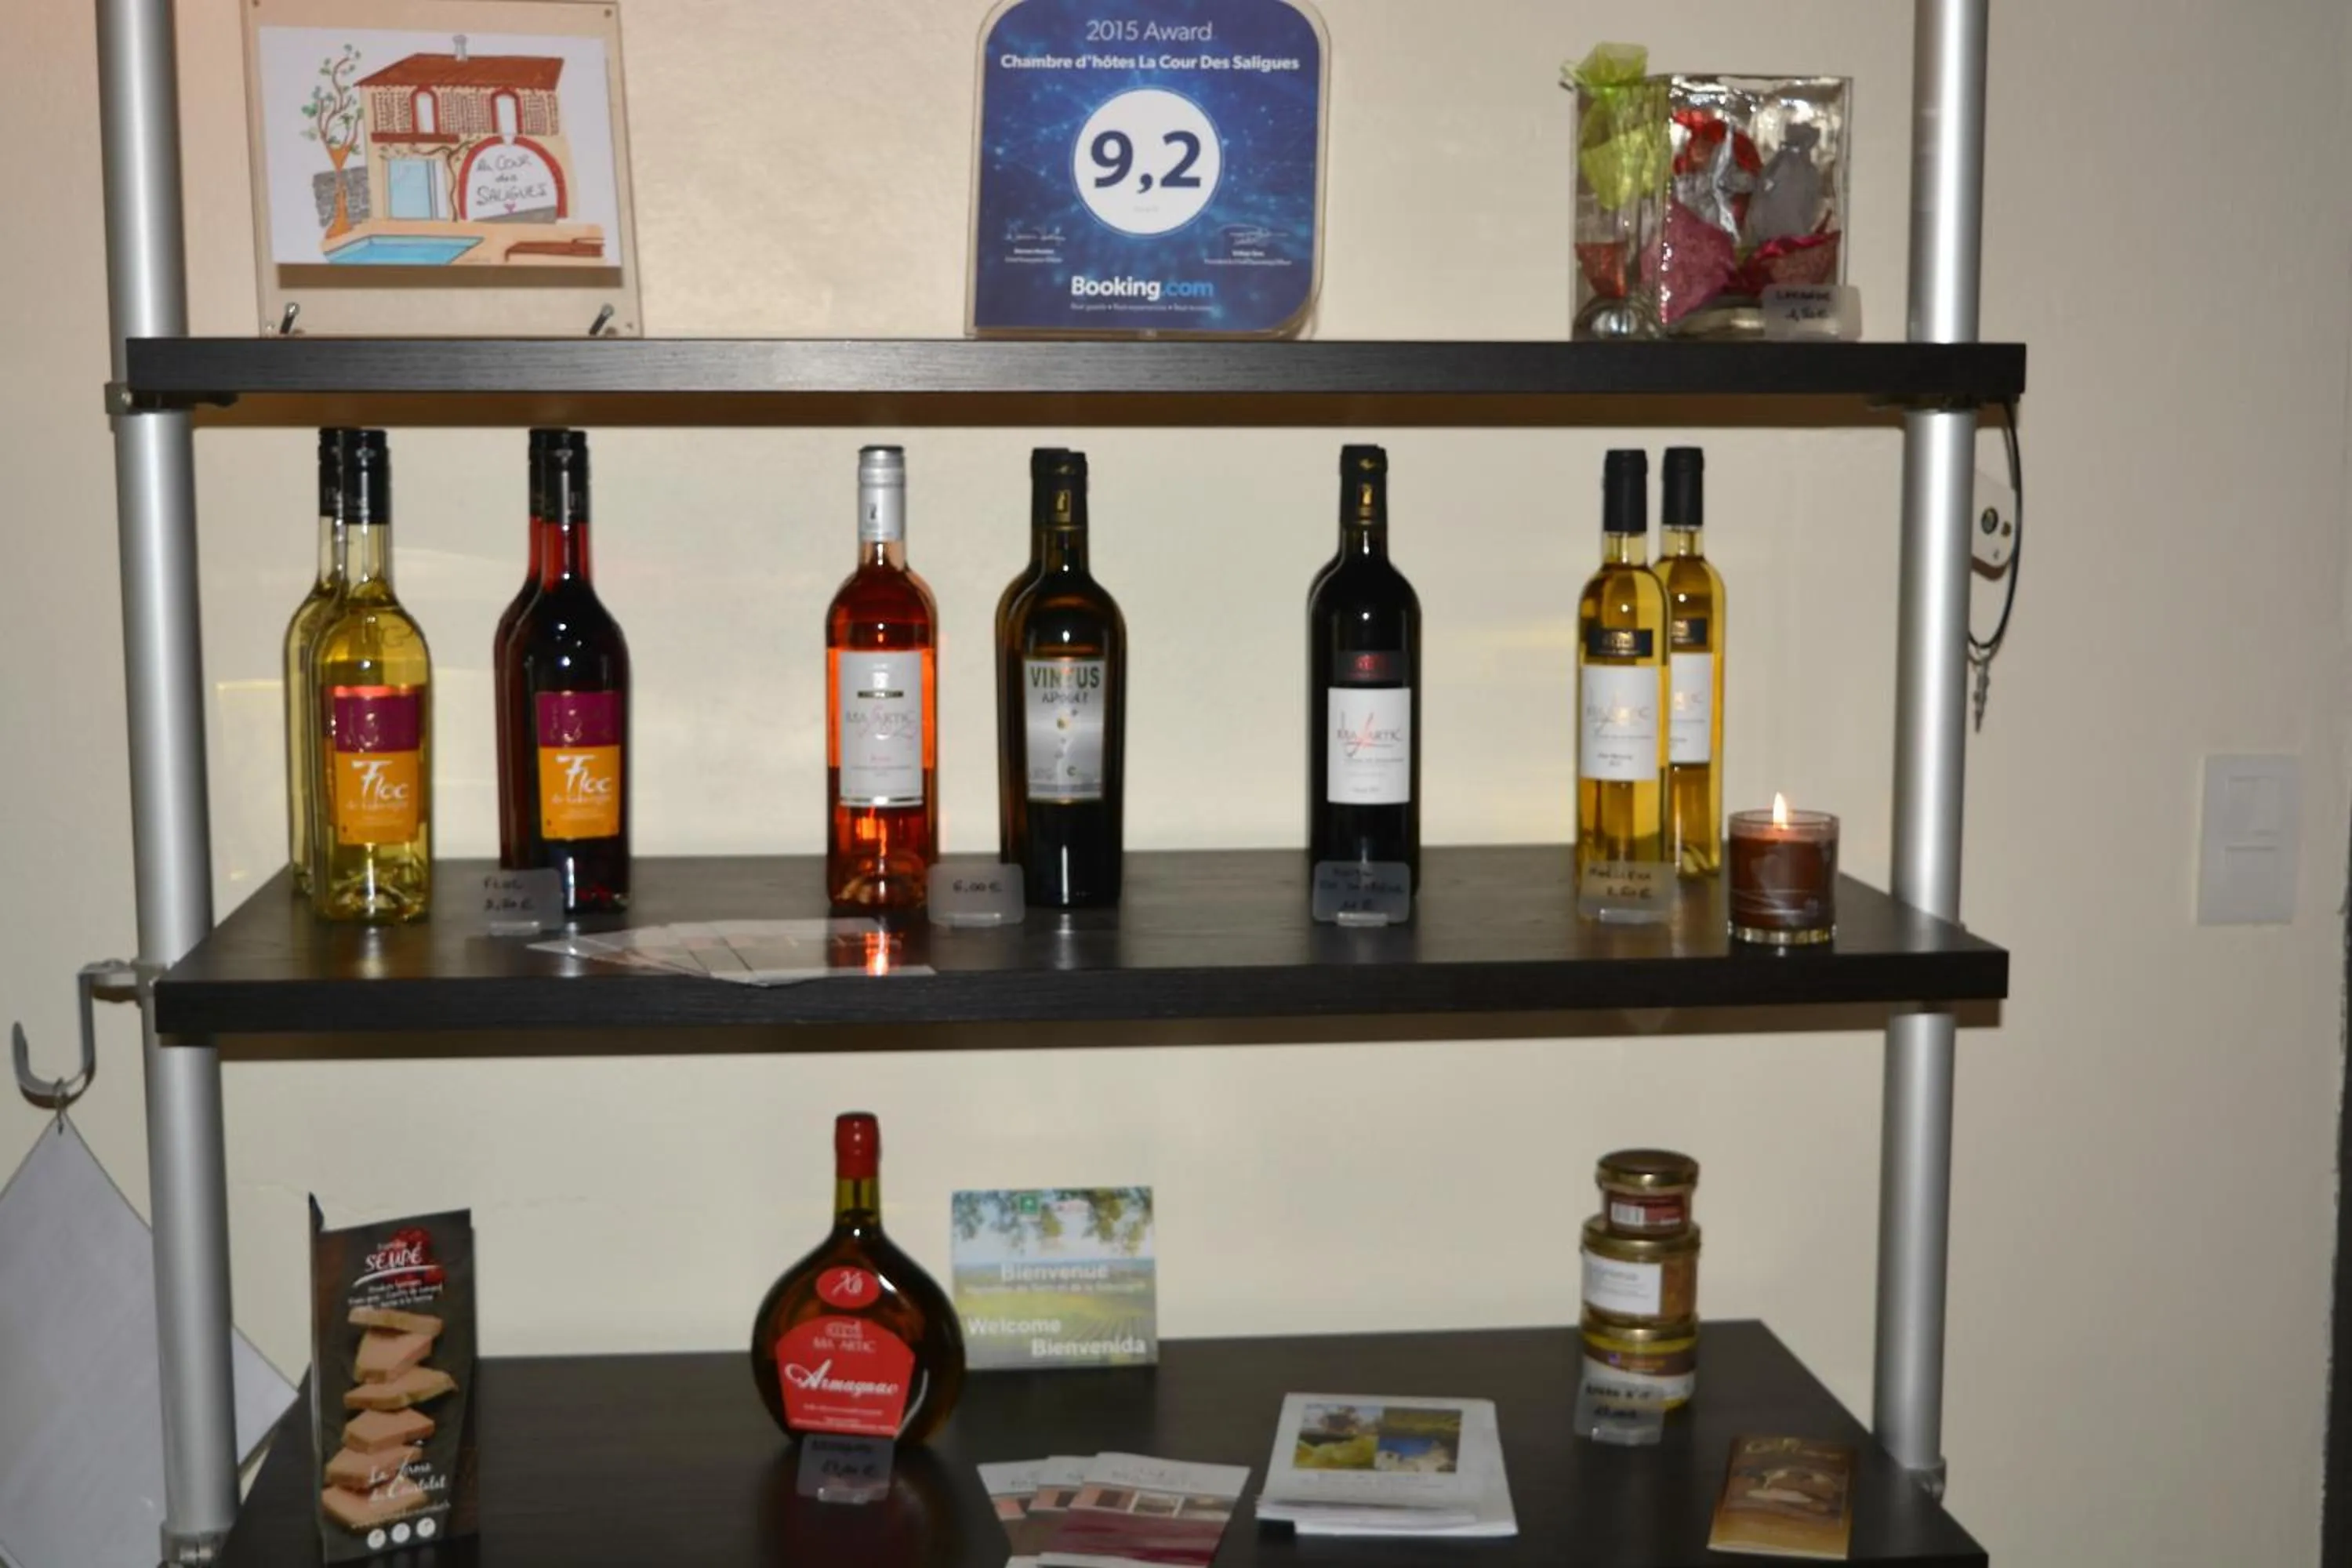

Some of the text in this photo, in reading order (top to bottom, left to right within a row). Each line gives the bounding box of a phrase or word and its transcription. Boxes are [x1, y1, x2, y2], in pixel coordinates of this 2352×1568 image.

[1086, 20, 1214, 42] 2015 Award
[1000, 54, 1072, 69] Chambre
[1138, 55, 1157, 69] La
[1159, 55, 1197, 69] Cour
[1200, 55, 1230, 69] Des
[1232, 55, 1301, 72] Saligues
[1090, 129, 1203, 194] 9,2
[1070, 275, 1214, 301] Booking.com
[1001, 1263, 1109, 1282] Bienvenue
[967, 1317, 1062, 1335] Welcome
[1031, 1335, 1147, 1359] Bienvenida
[785, 1359, 899, 1398] Armagnac
